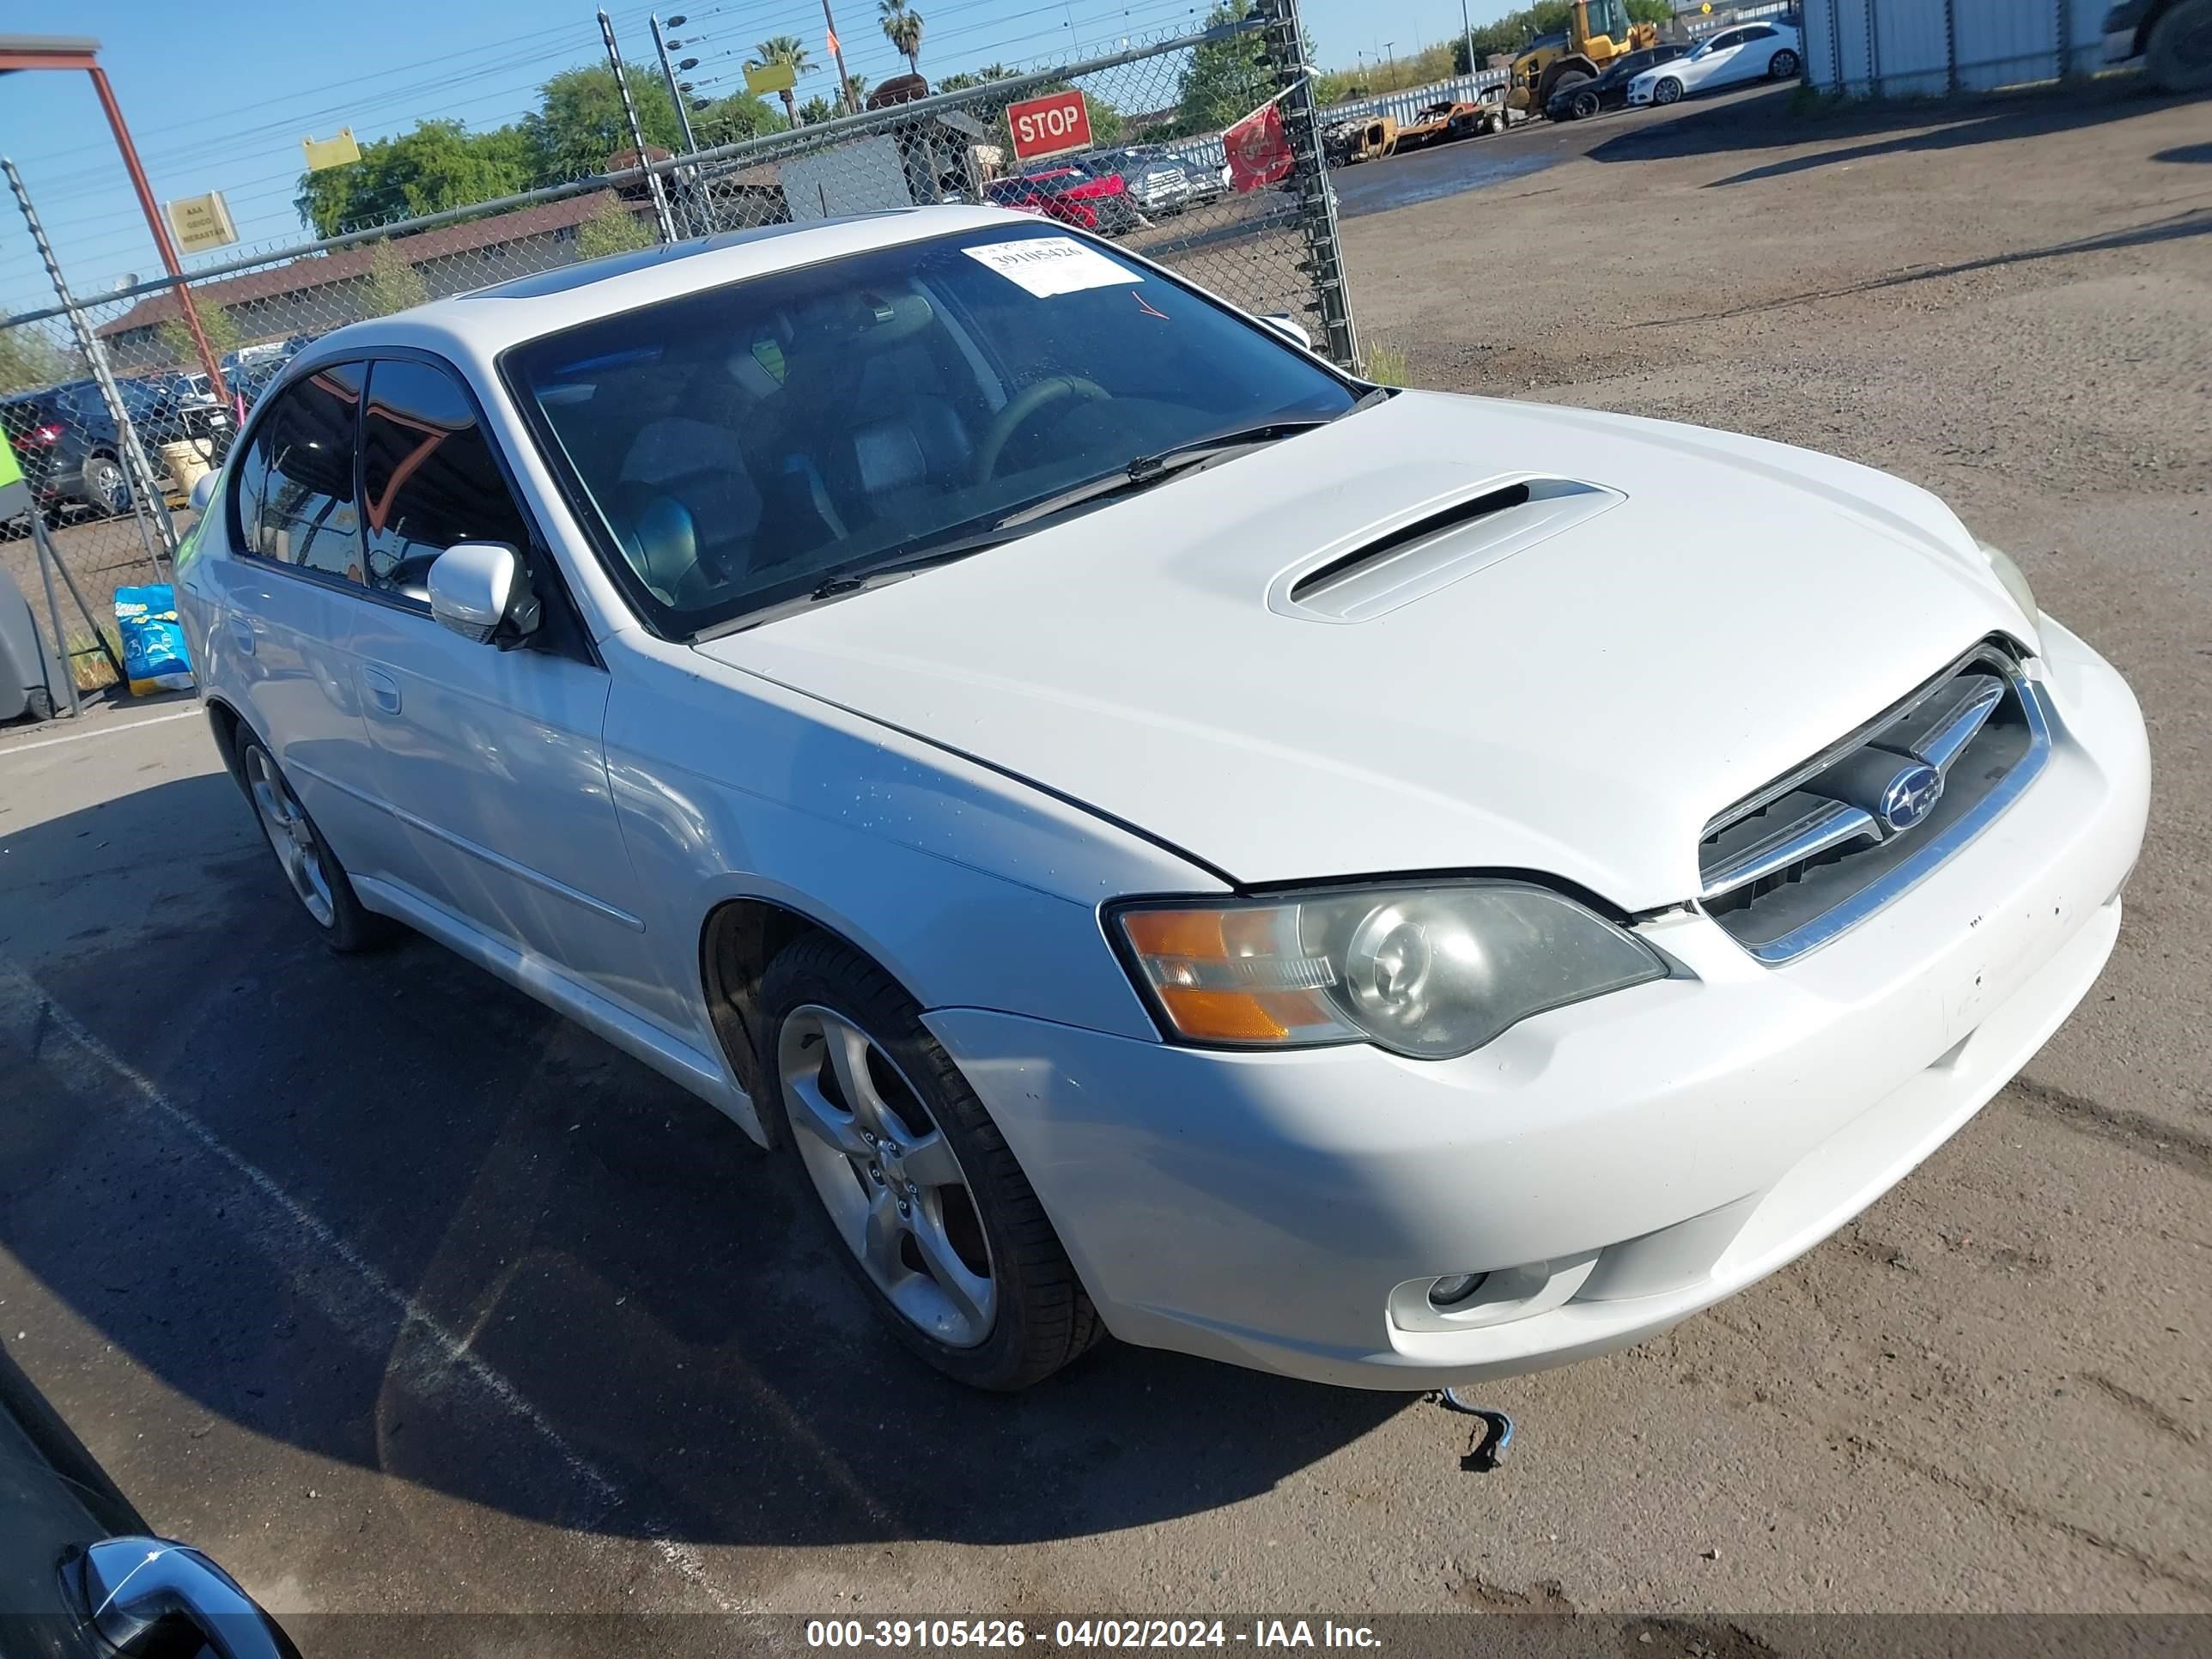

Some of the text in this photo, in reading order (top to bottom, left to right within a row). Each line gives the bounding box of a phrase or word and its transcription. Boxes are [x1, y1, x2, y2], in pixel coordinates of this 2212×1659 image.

[1019, 106, 1079, 143] STOP
[186, 206, 204, 216] AAA
[186, 217, 212, 228] GEICO
[992, 246, 1083, 266] 39105426
